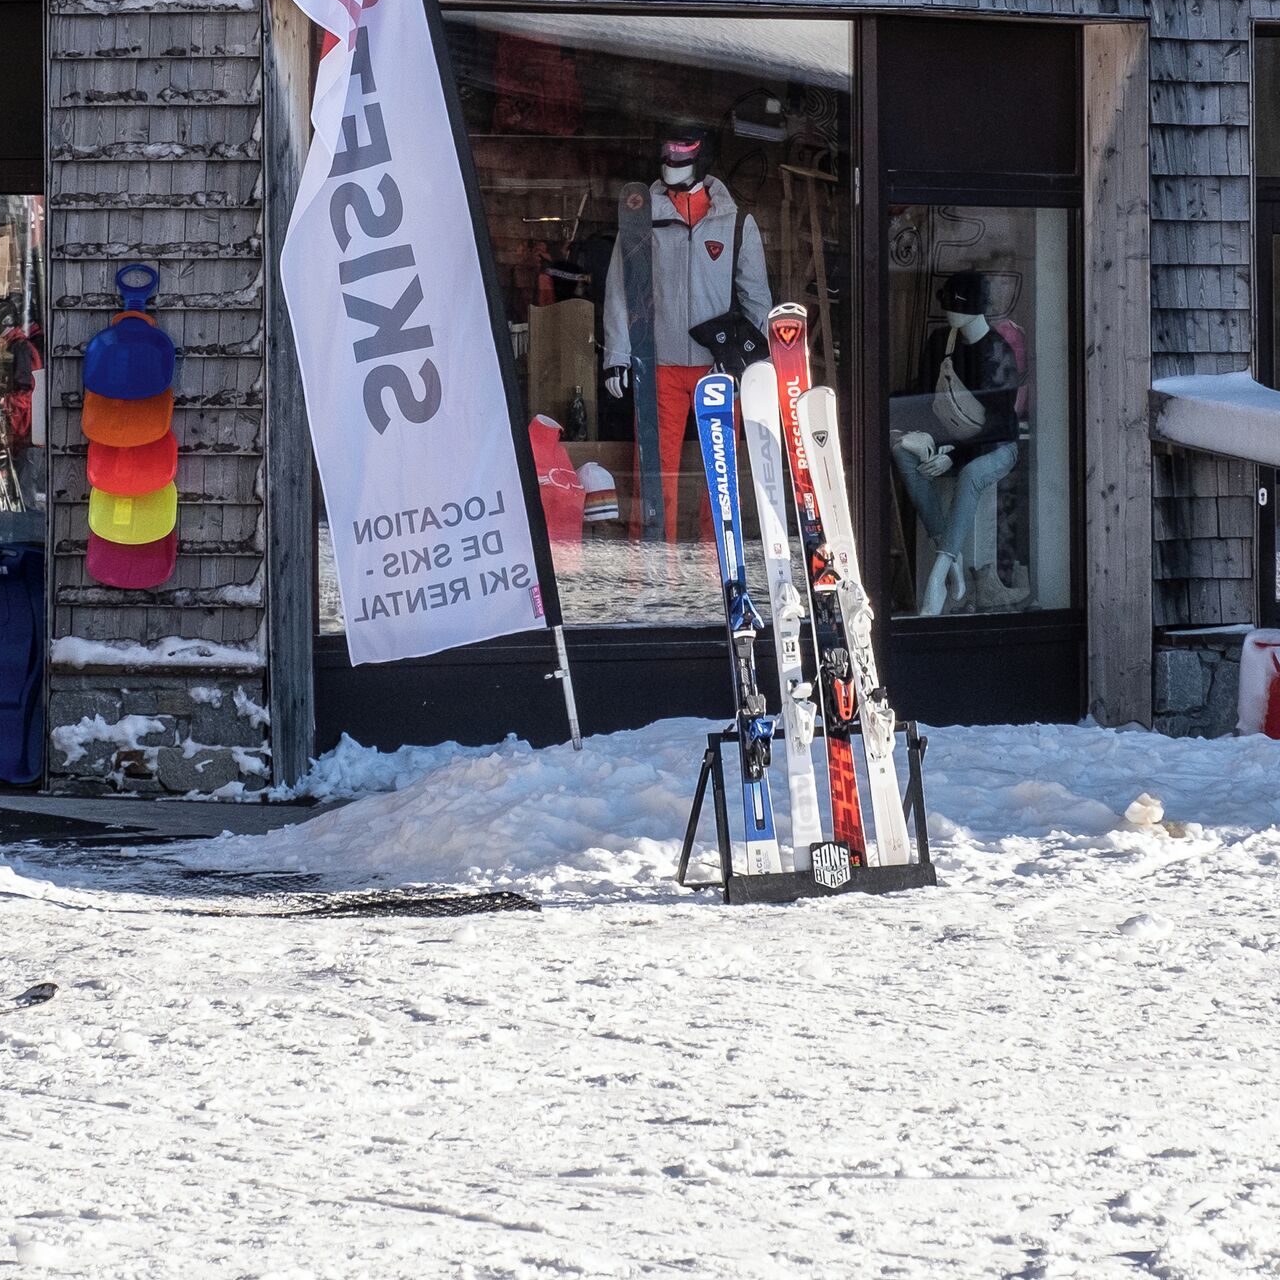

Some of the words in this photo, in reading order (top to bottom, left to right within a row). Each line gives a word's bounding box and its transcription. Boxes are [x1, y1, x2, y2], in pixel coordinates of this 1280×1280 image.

[710, 418, 733, 505] SALOMON
[758, 419, 778, 505] HEAD
[812, 843, 848, 868] SONS
